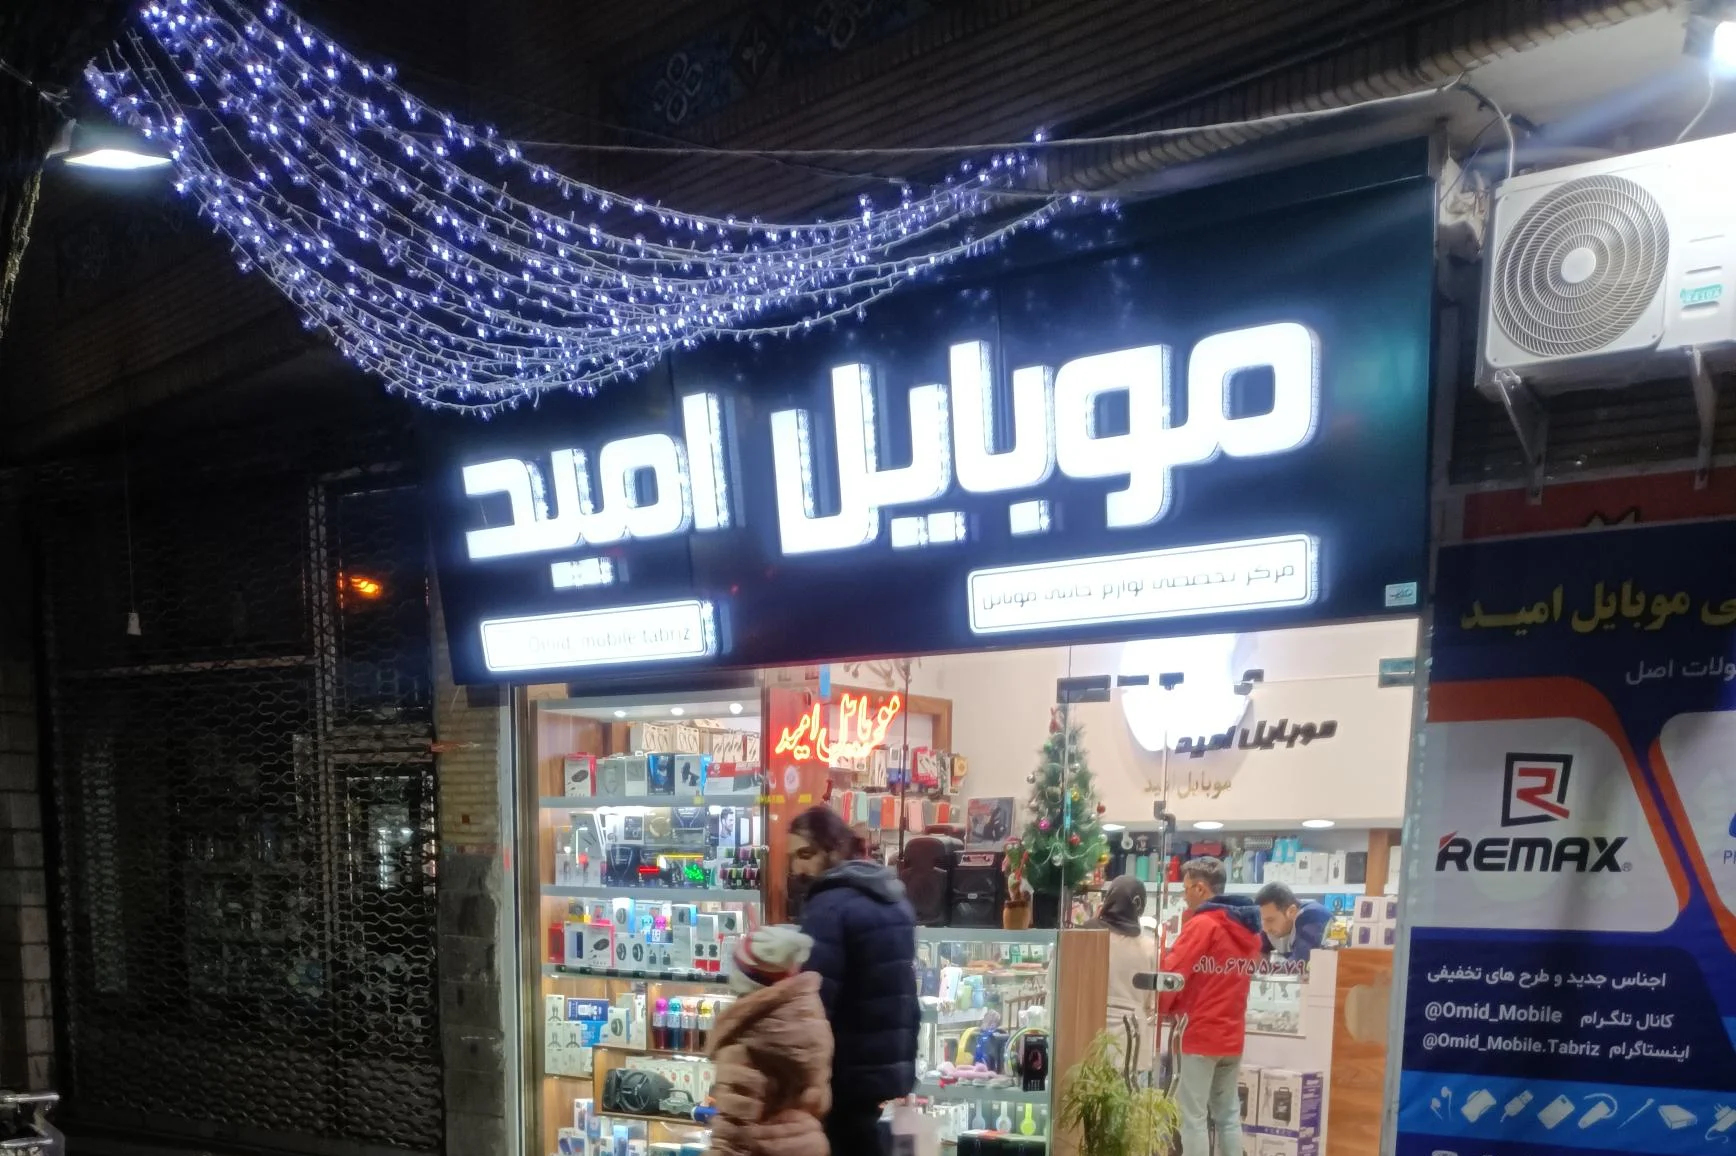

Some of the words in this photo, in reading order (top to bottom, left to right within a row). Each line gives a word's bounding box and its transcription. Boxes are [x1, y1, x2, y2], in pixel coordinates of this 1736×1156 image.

[771, 320, 1320, 556] موبایل
[461, 392, 731, 590] امید
[1247, 564, 1295, 586] مرکز
[1460, 584, 1564, 636] امید
[1571, 579, 1690, 633] موبایل
[1625, 659, 1674, 686] اصل
[1174, 725, 1237, 759] امید
[1238, 719, 1338, 751] موبایل
[1434, 831, 1629, 873] REMAX
[1427, 965, 1482, 984] تخفیفی
[1485, 968, 1515, 985] های
[1518, 969, 1550, 989] طرح
[1554, 974, 1563, 988] و
[1566, 973, 1607, 989] جدید
[1612, 972, 1667, 991] اجناس
[1424, 1001, 1563, 1023] @Omid_Mobile
[1580, 1010, 1633, 1029] تلگرام
[1636, 1013, 1675, 1031] کانال
[1422, 1033, 1601, 1057] @Omid_Mobile.Tabriz
[1608, 1042, 1690, 1063] اینستاگرام
